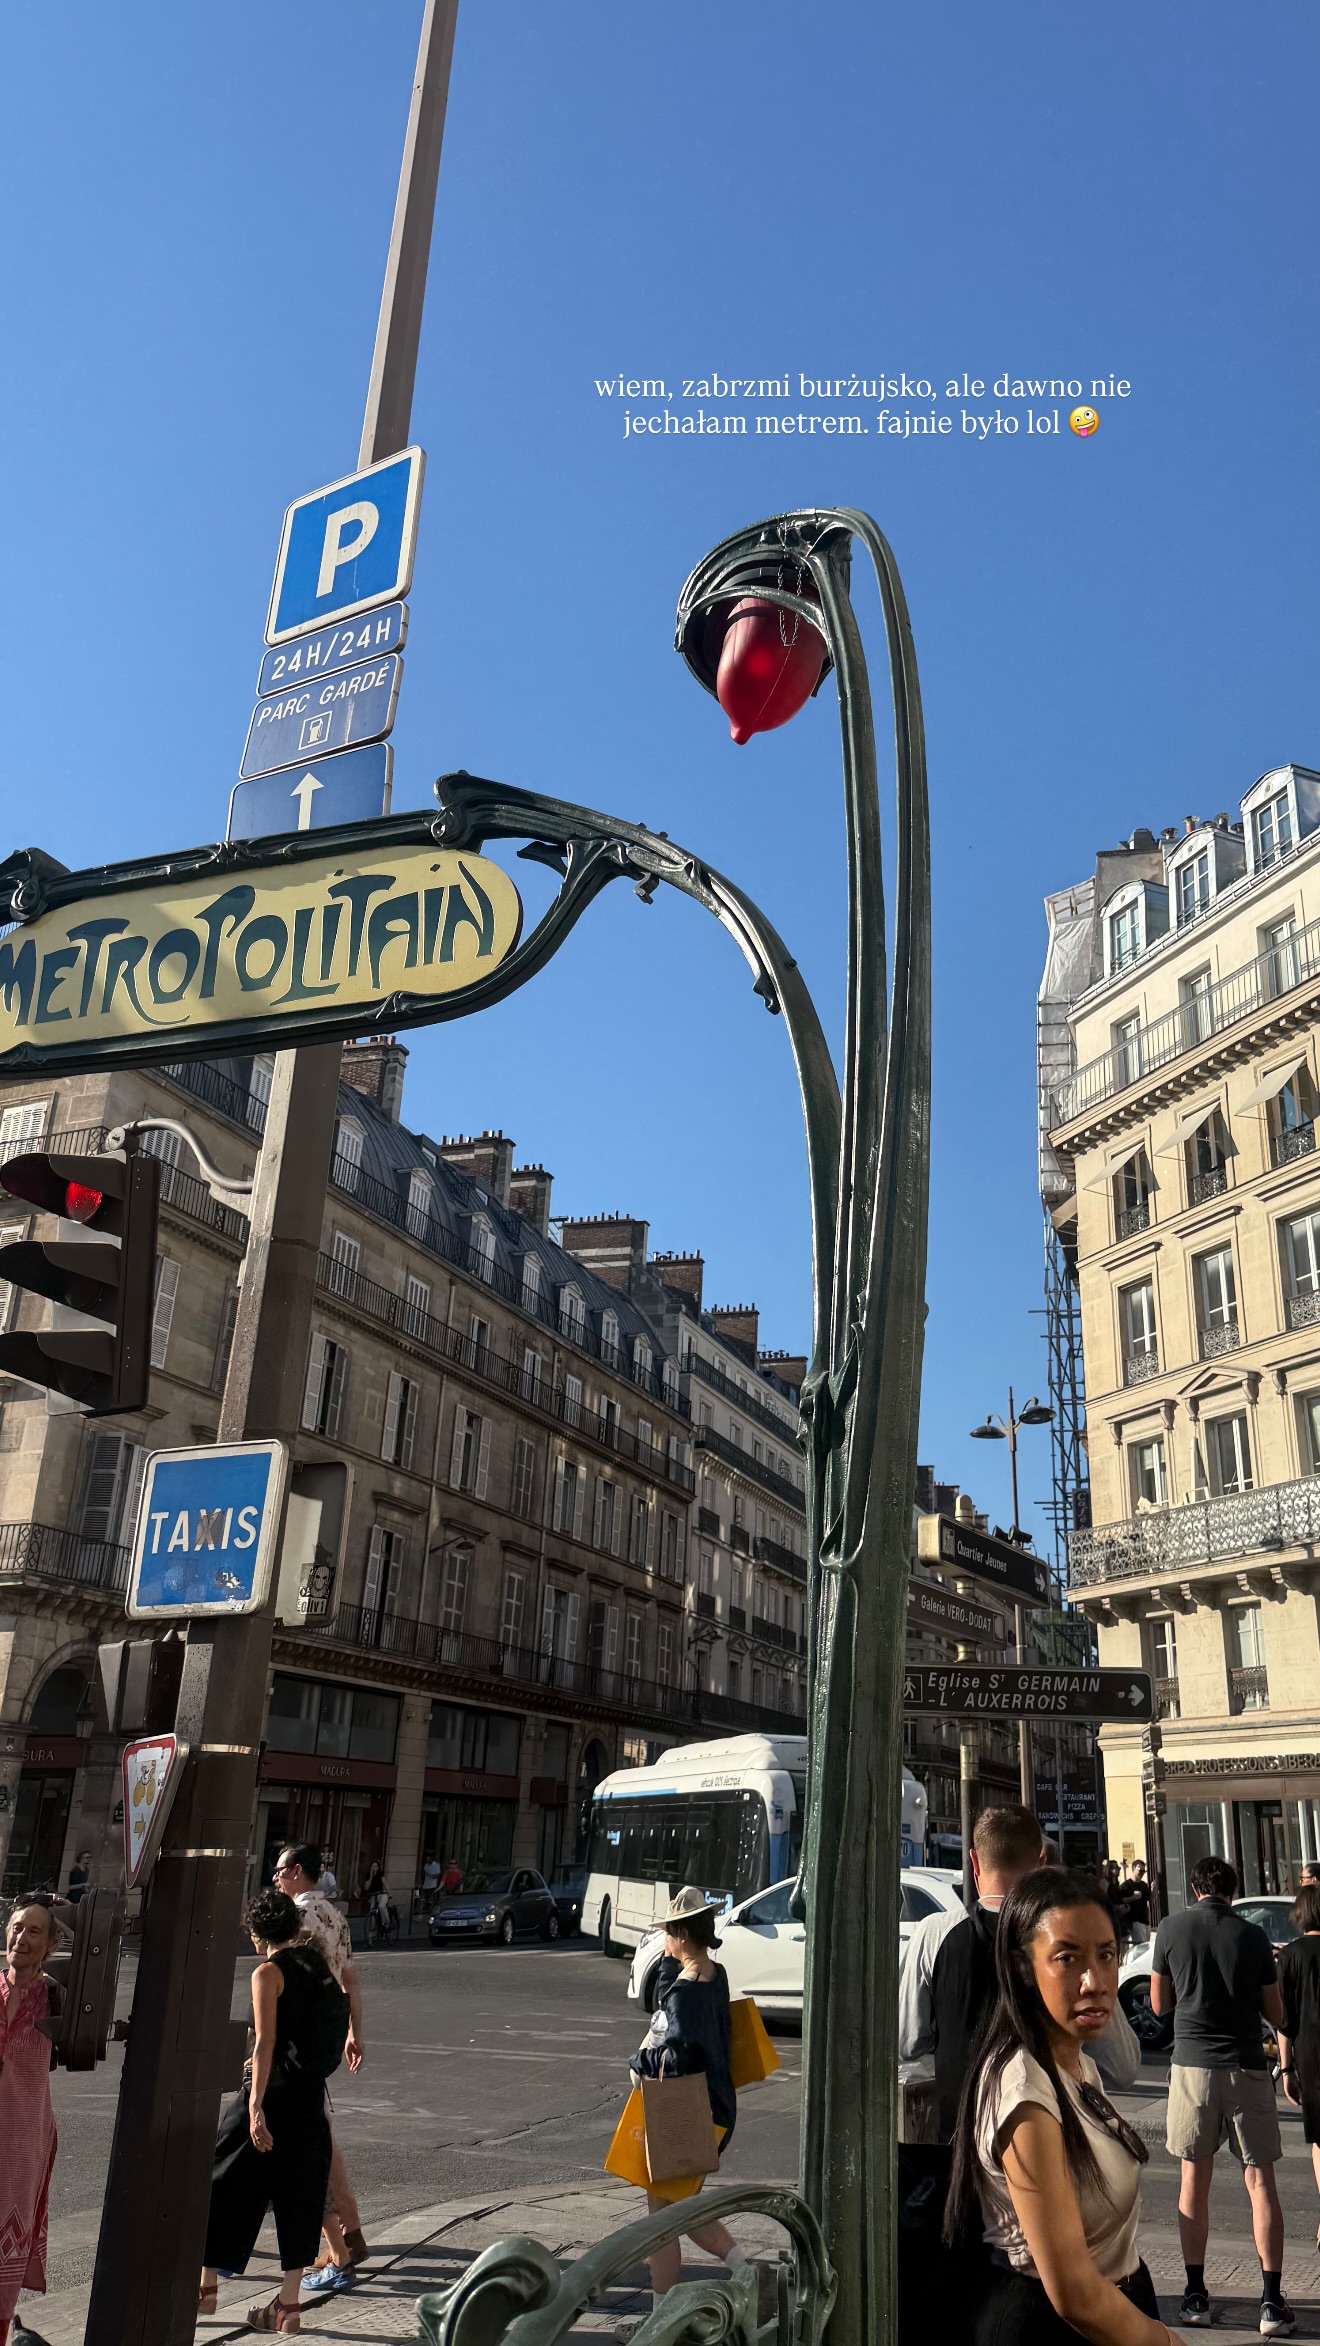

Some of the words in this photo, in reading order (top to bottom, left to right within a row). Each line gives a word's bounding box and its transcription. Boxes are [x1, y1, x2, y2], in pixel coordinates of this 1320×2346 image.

[316, 500, 379, 598] P
[271, 617, 391, 680] 24H/24H
[257, 694, 310, 727] PARC
[319, 662, 390, 705] GARDÉ
[0, 860, 495, 1026] METROPOLITAIN
[150, 1505, 259, 1554] TAXIS
[957, 1540, 984, 1563] Quartier
[985, 1552, 1008, 1573] Jeunes
[920, 1594, 946, 1616] Galerie
[947, 1603, 992, 1633] VERO-DODAT
[927, 1671, 980, 1691] Eglise
[1018, 1675, 1101, 1693] GERMAIN
[963, 1692, 1068, 1710] AUXERROIS
[1195, 1755, 1278, 1775] PROFESSIONS
